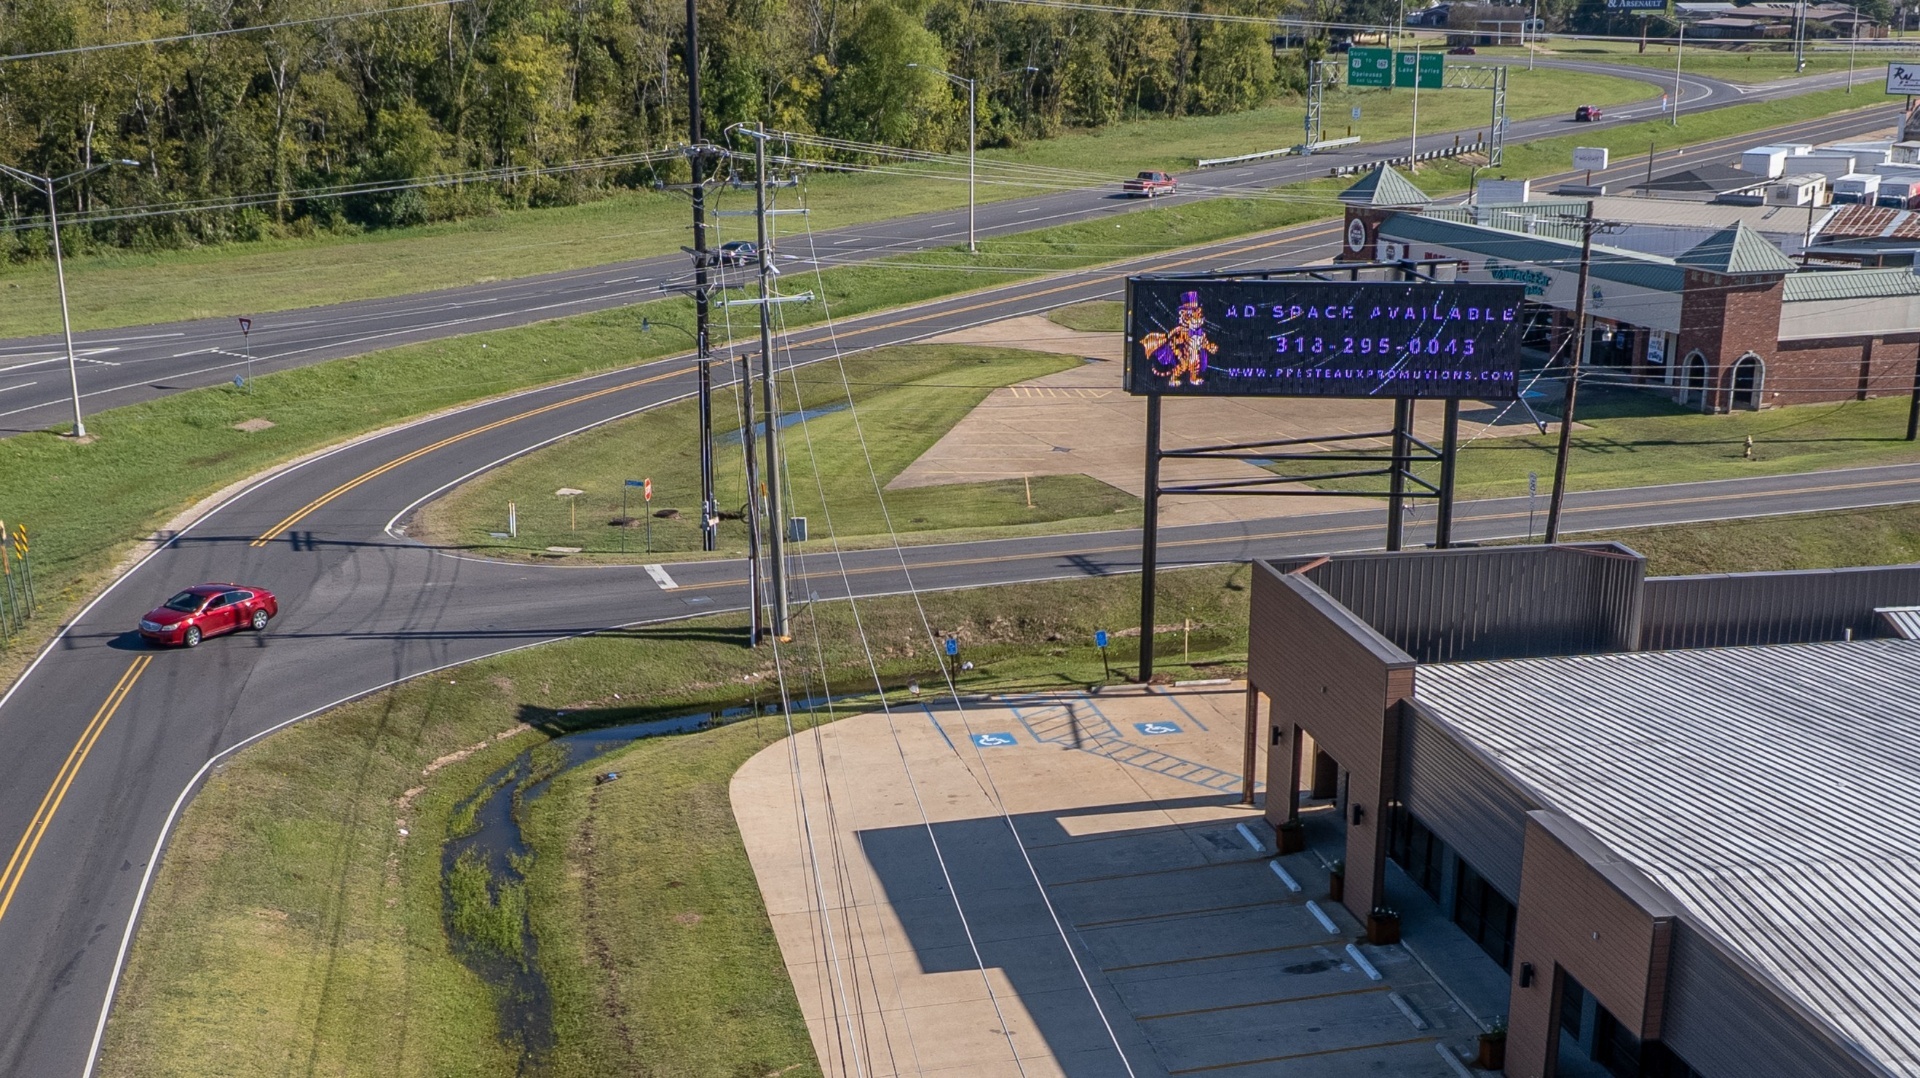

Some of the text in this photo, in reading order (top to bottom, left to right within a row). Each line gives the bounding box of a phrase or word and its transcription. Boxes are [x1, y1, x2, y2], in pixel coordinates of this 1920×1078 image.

[1607, 0, 1617, 8] &
[1226, 305, 1514, 321] AD SPACE AVAILABLE
